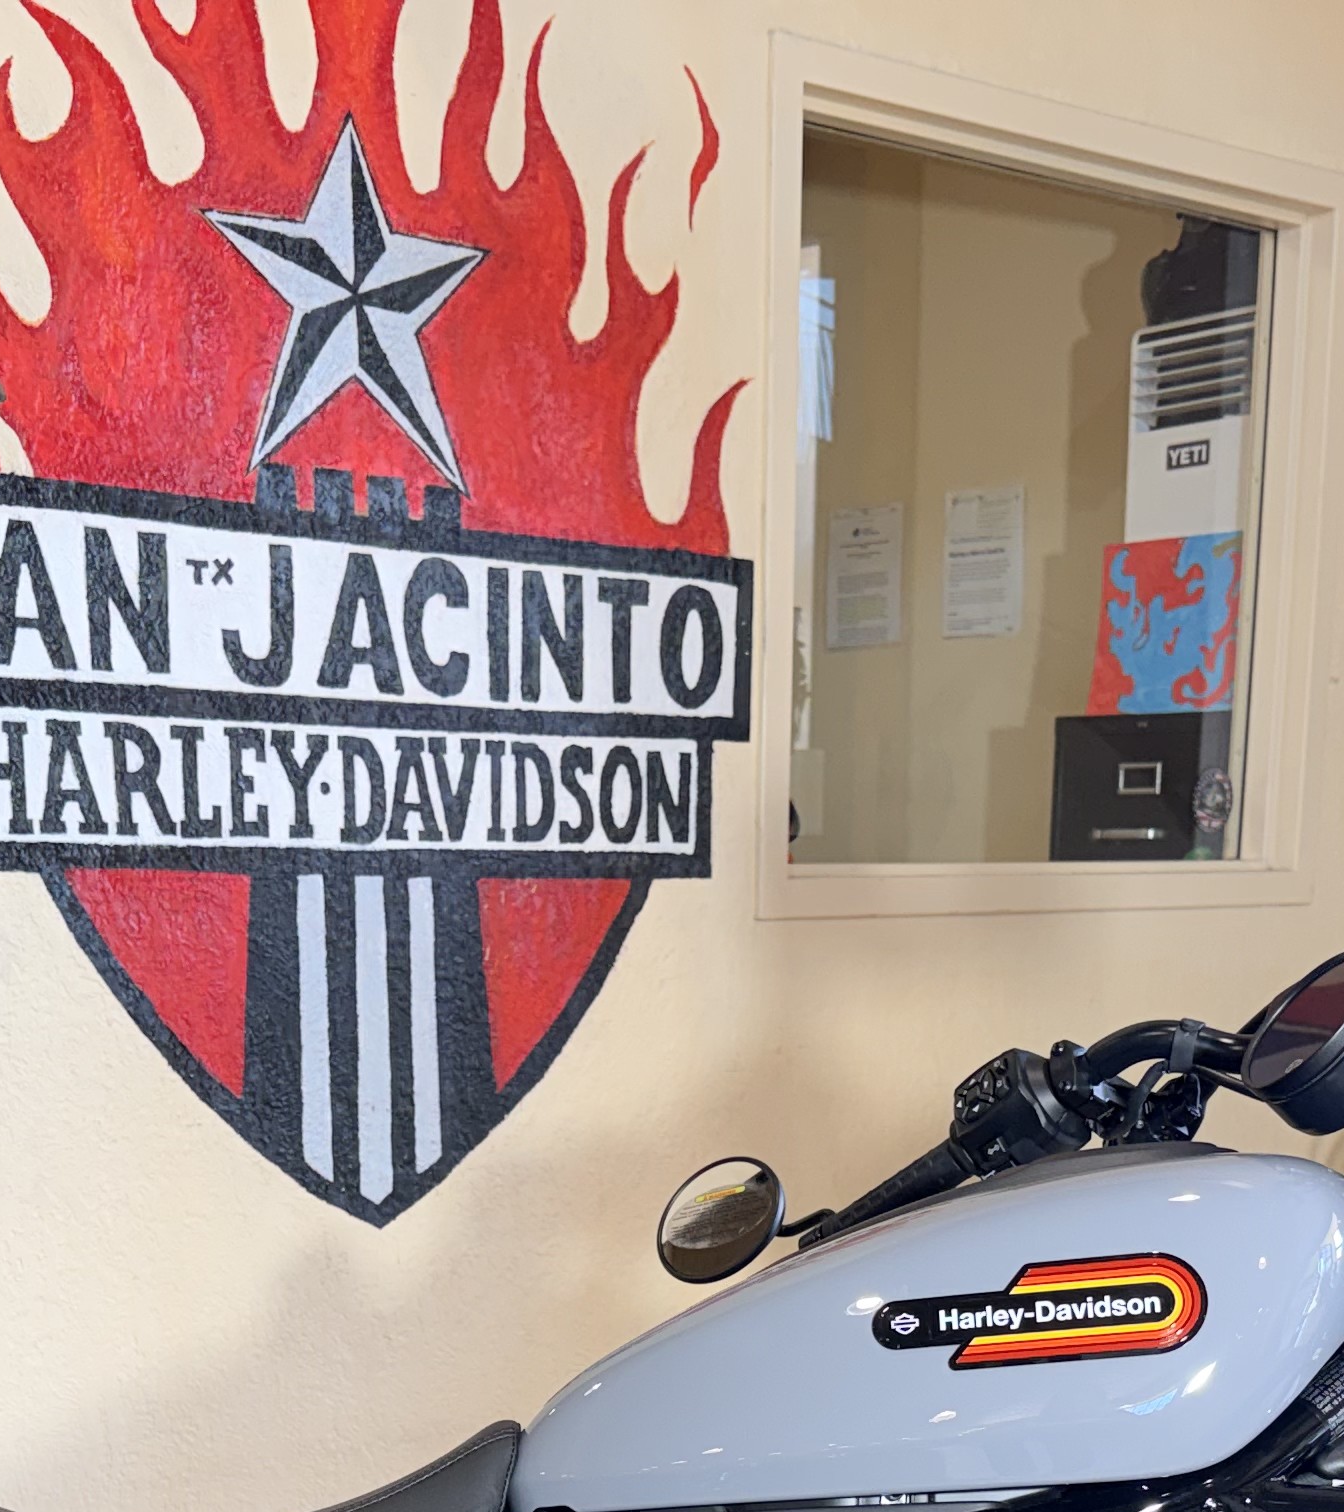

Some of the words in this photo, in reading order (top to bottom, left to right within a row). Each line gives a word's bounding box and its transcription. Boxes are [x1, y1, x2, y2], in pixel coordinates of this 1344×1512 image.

[1168, 444, 1208, 467] YETI
[185, 558, 234, 586] TX
[221, 543, 723, 710] JACINTO
[938, 1294, 1162, 1333] Harley-Davidson
